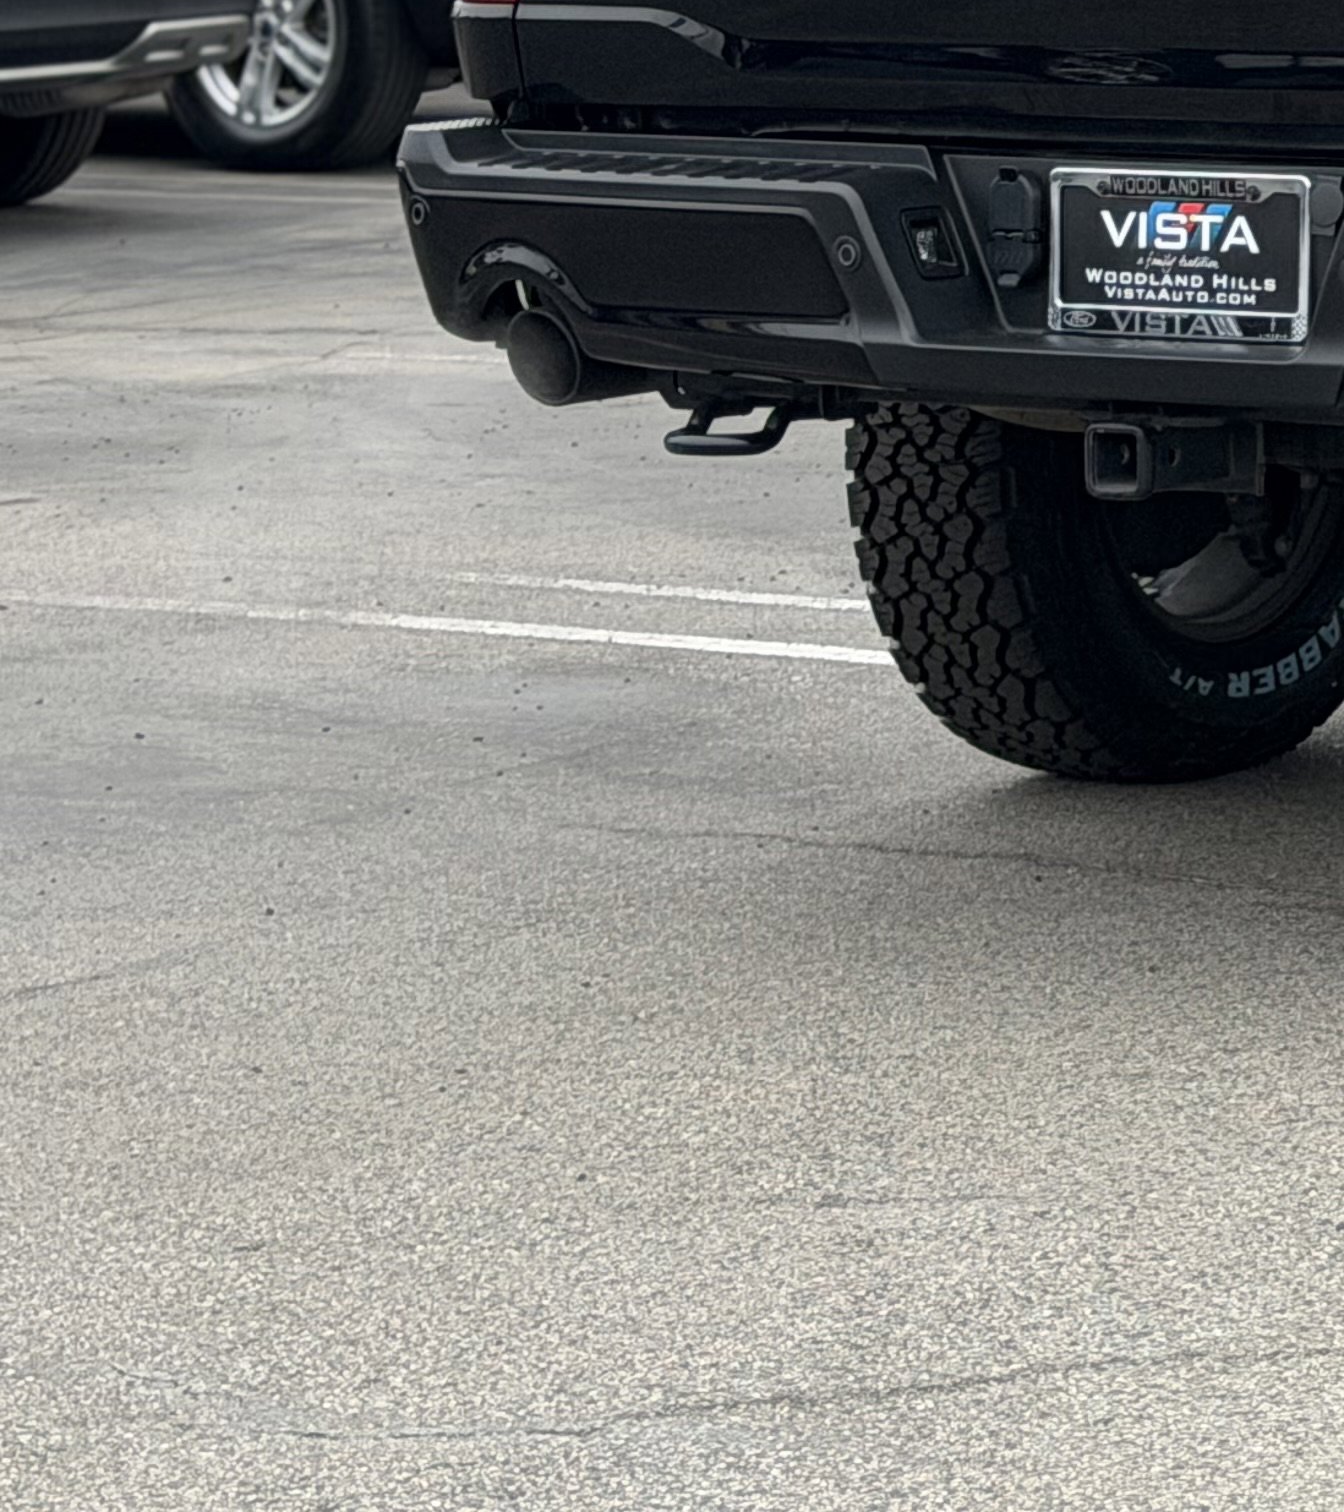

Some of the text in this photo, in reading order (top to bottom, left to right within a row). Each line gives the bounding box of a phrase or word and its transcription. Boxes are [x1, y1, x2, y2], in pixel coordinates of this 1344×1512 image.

[1111, 176, 1247, 198] WOODLAND HILLS
[1100, 209, 1261, 255] VISTA
[1085, 267, 1277, 293] WOODLAND HILLS
[1111, 311, 1216, 337] VISTA
[1169, 666, 1214, 696] A/T
